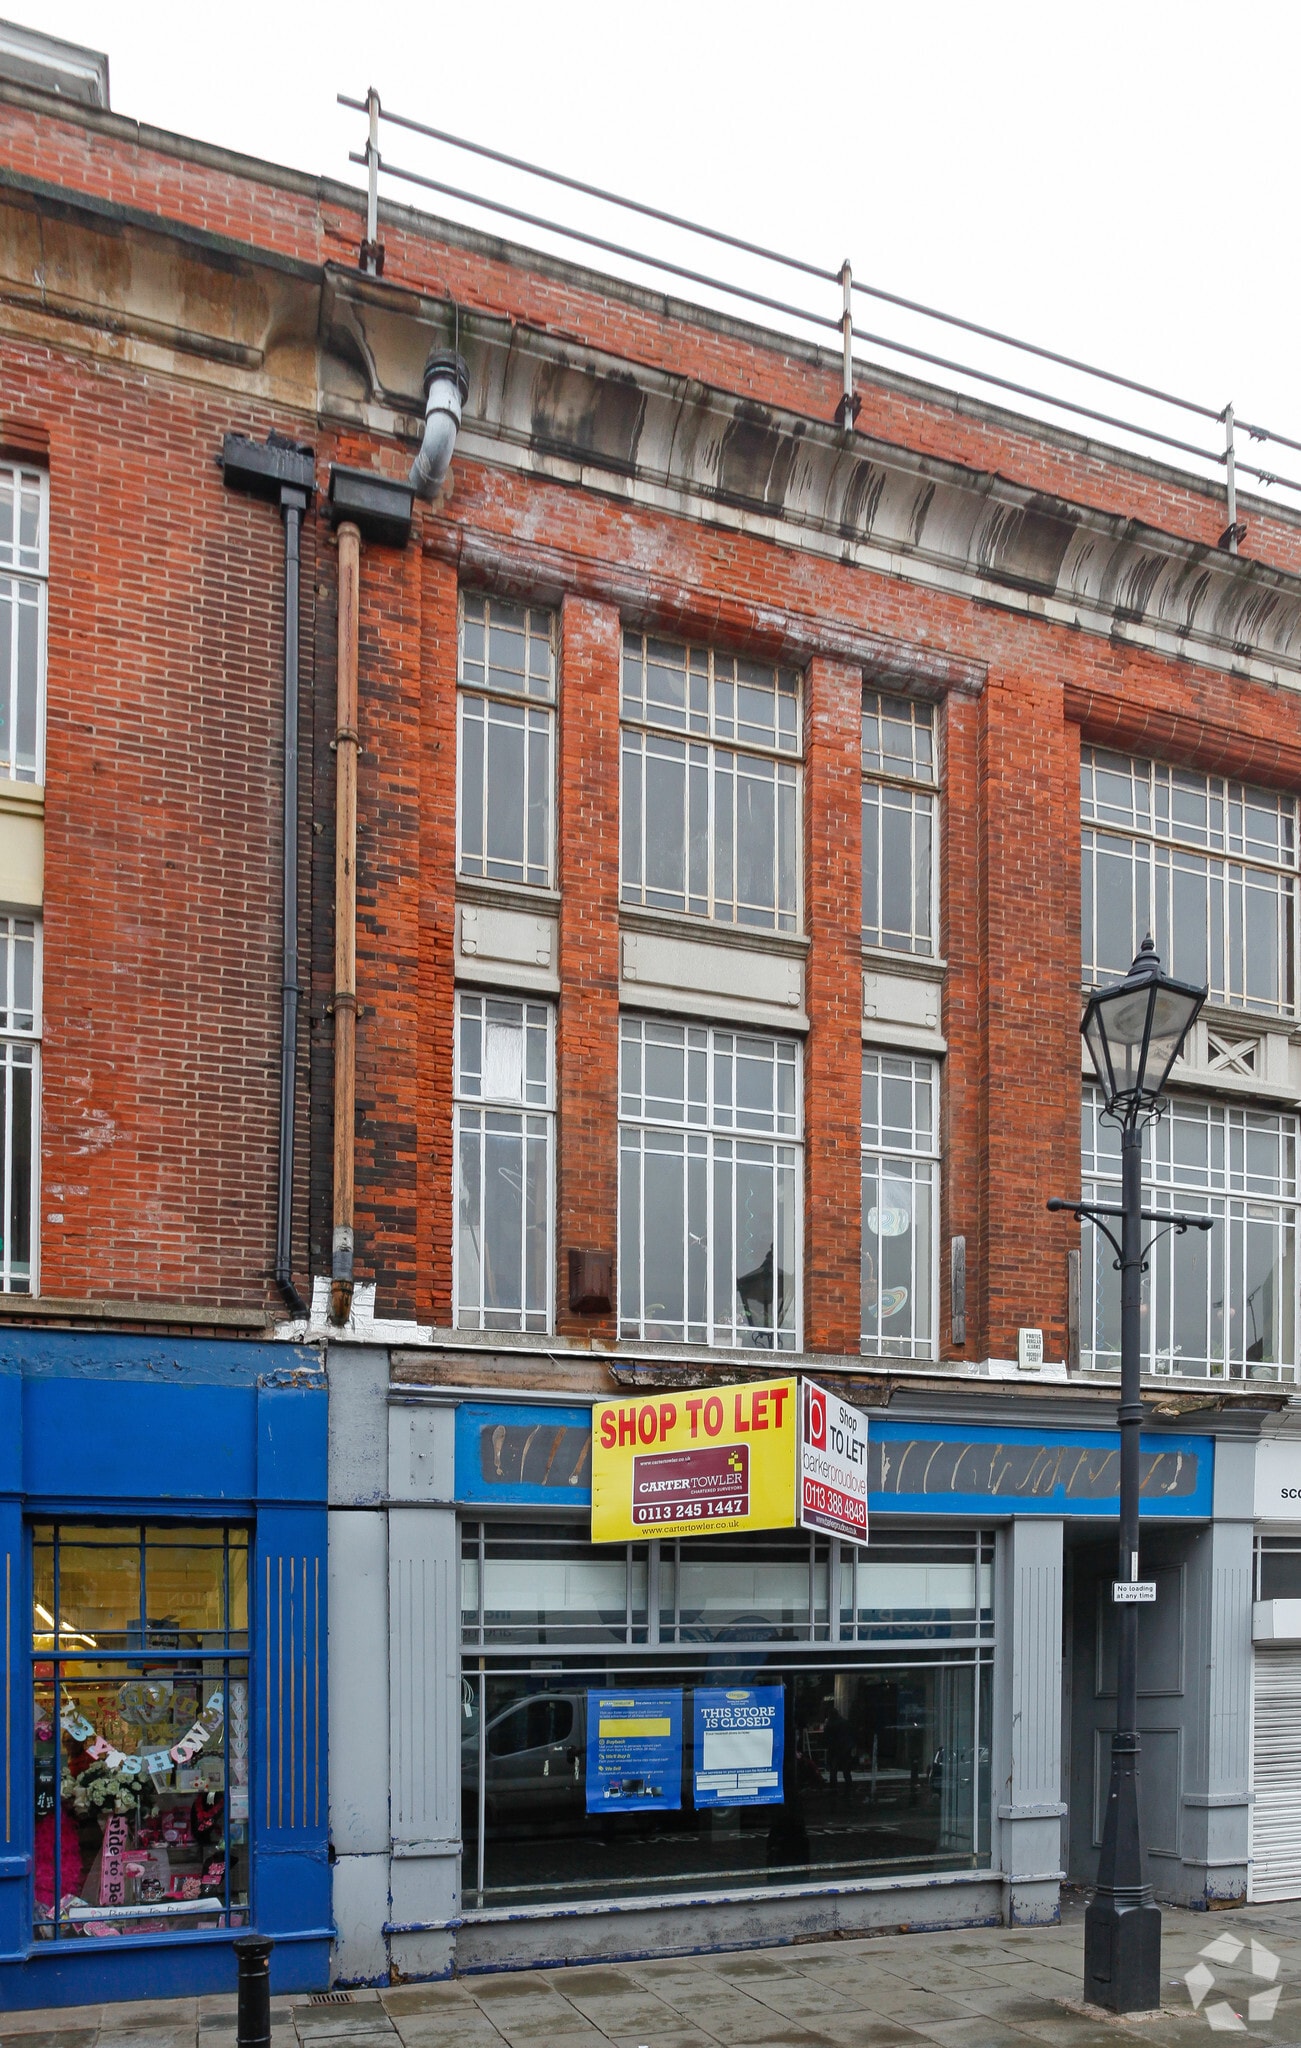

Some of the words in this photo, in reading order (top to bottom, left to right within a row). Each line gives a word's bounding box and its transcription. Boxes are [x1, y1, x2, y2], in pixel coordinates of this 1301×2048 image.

[600, 1403, 677, 1449] SHOP
[685, 1396, 723, 1438] TO
[735, 1388, 788, 1432] LET
[839, 1406, 858, 1435] Shop
[829, 1425, 844, 1455] TO
[846, 1437, 865, 1465] LET
[803, 1447, 867, 1495] barkerproudlove
[717, 1485, 742, 1493] SURVEYORS
[638, 1506, 671, 1521] 0113
[676, 1503, 702, 1518] 245
[707, 1500, 742, 1515] 1447
[805, 1482, 826, 1509] 0113
[827, 1490, 844, 1517] 388
[844, 1498, 865, 1524] 4848
[642, 1520, 740, 1535] www.cartertowler.co.uk
[701, 1707, 732, 1719] THIS
[734, 1706, 776, 1718] STORE
[706, 1718, 719, 1729] IS
[720, 1716, 771, 1728] CLOSED
[109, 1816, 125, 1856] ride
[109, 1861, 121, 1876] to
[109, 1882, 121, 1903] Be
